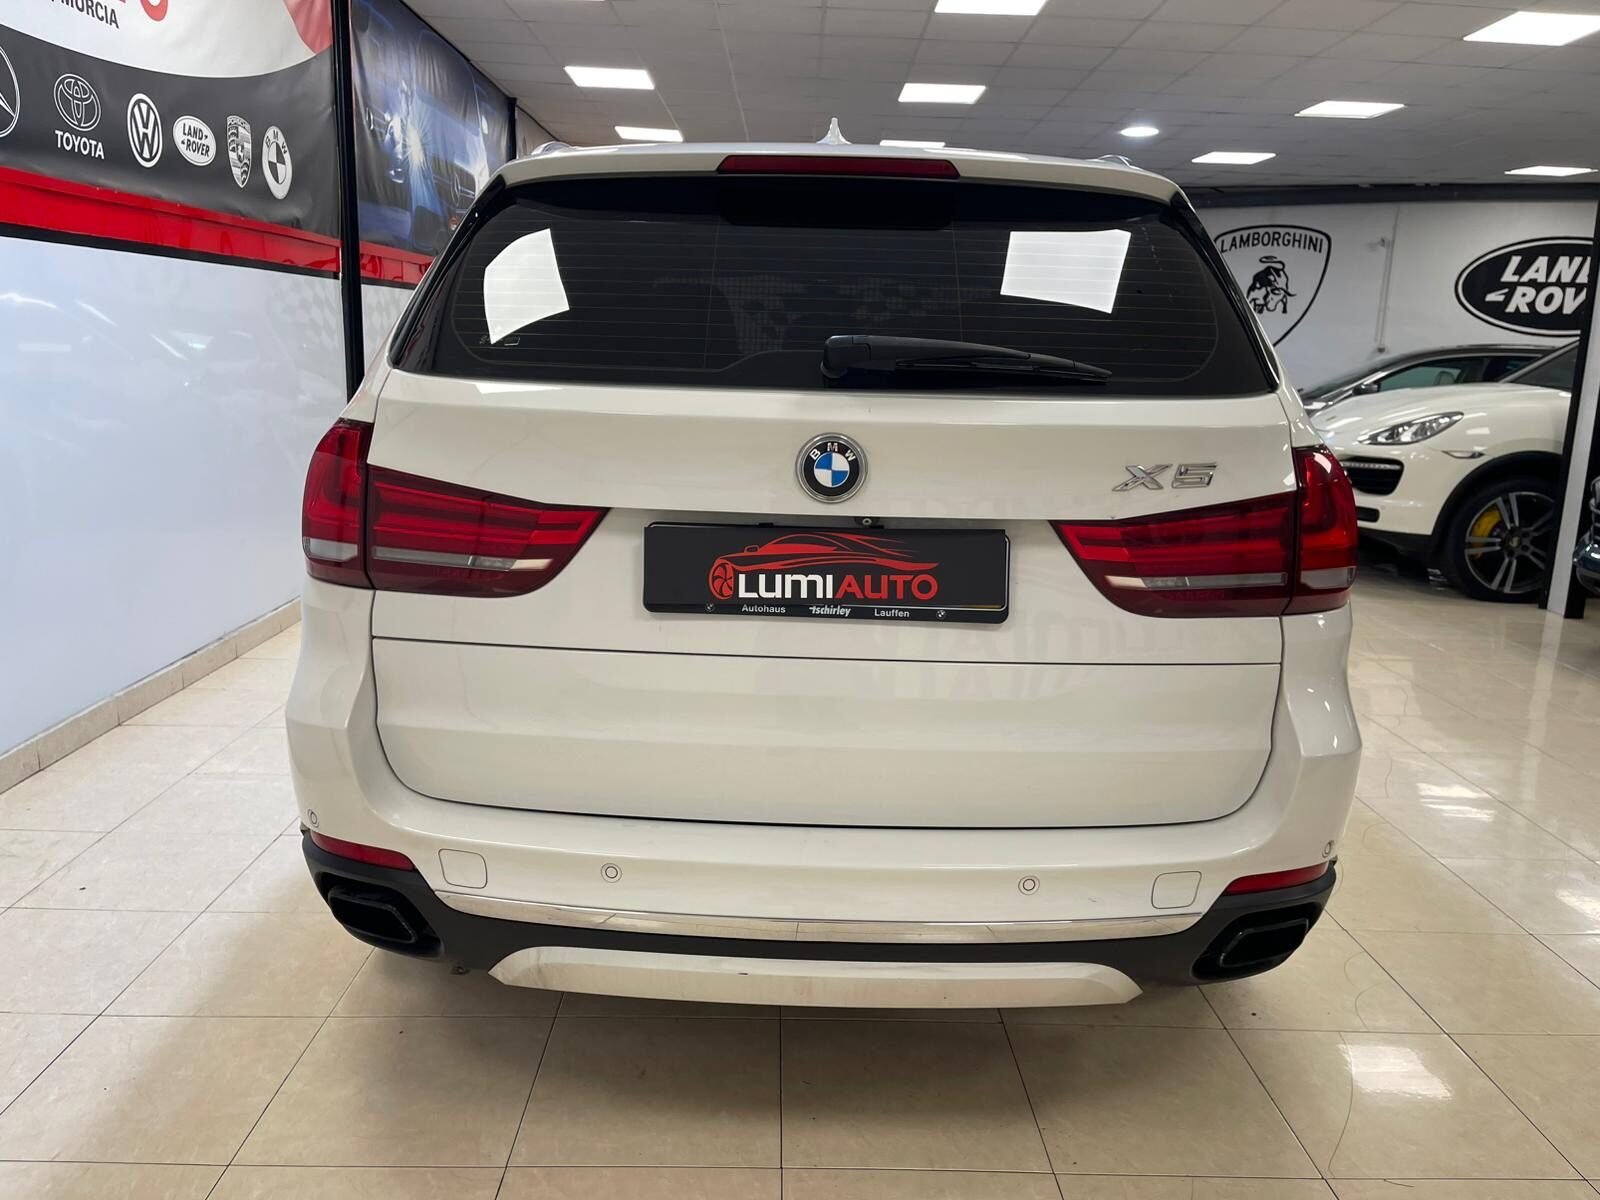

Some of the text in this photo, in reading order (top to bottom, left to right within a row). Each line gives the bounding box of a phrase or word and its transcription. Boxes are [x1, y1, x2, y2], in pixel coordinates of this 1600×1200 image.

[182, 122, 204, 141] LAND
[54, 129, 105, 160] TOYOTA
[185, 139, 210, 158] ROVER
[1219, 231, 1324, 254] LAMBORGHINI
[809, 442, 857, 462] BMW
[1111, 462, 1217, 492] X5
[741, 603, 786, 614] Autohaus
[874, 608, 910, 618] Lauffen
